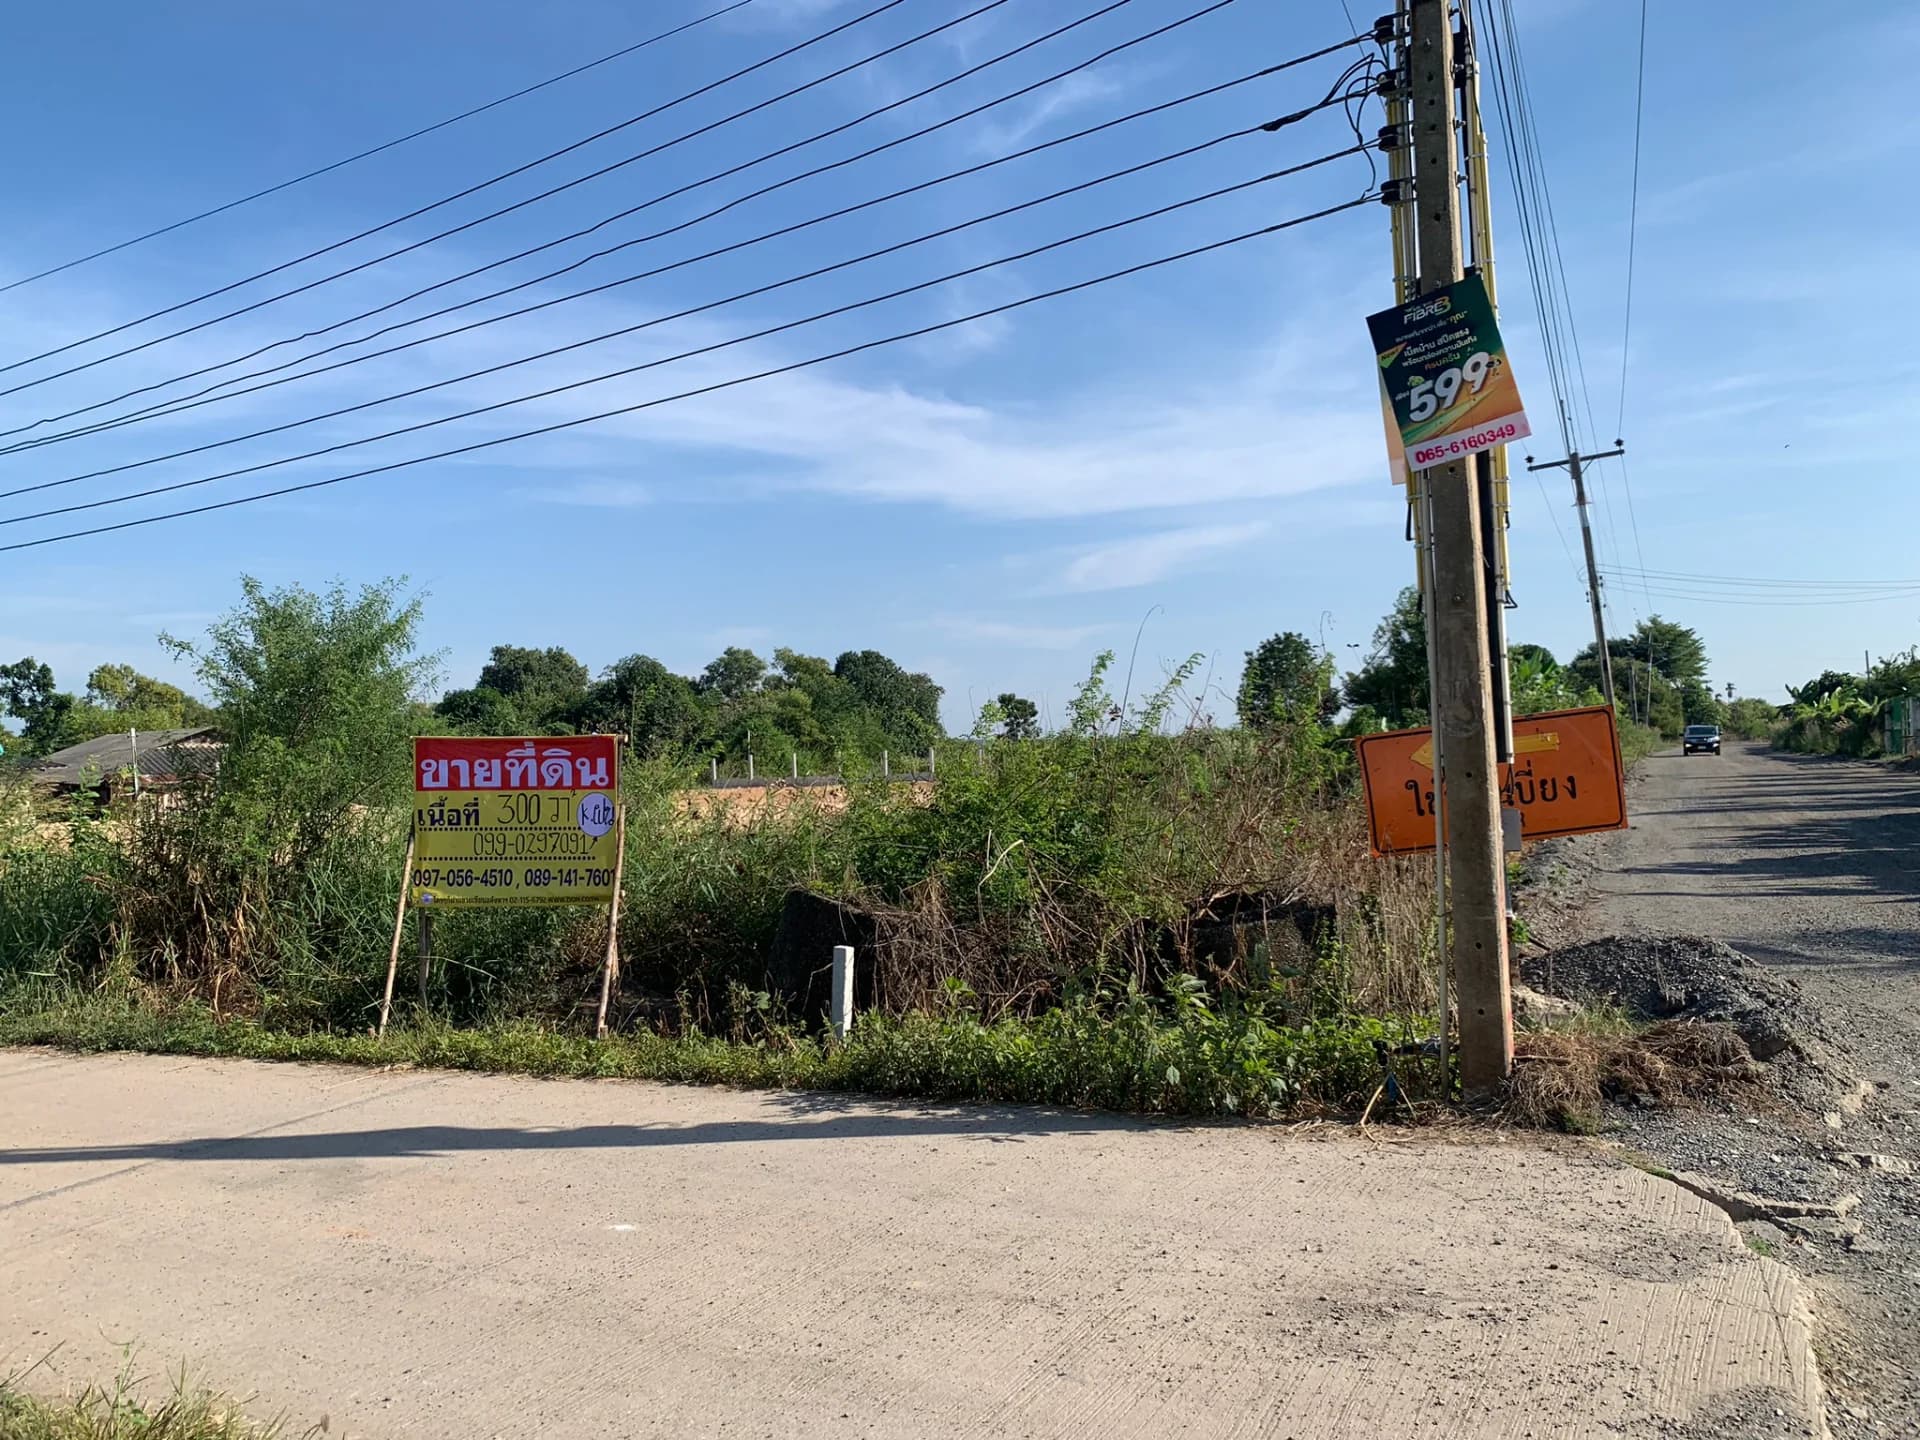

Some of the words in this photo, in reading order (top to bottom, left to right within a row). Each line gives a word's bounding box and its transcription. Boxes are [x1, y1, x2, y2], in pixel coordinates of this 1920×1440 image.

[1409, 351, 1490, 423] 599
[1415, 424, 1516, 464] 065-6160349
[420, 741, 609, 789] ขายที่ดิน
[417, 796, 480, 827] เนื้อที่
[497, 792, 541, 825] 300
[473, 832, 590, 856] 099-0297091
[524, 867, 616, 887] 089-141-7601
